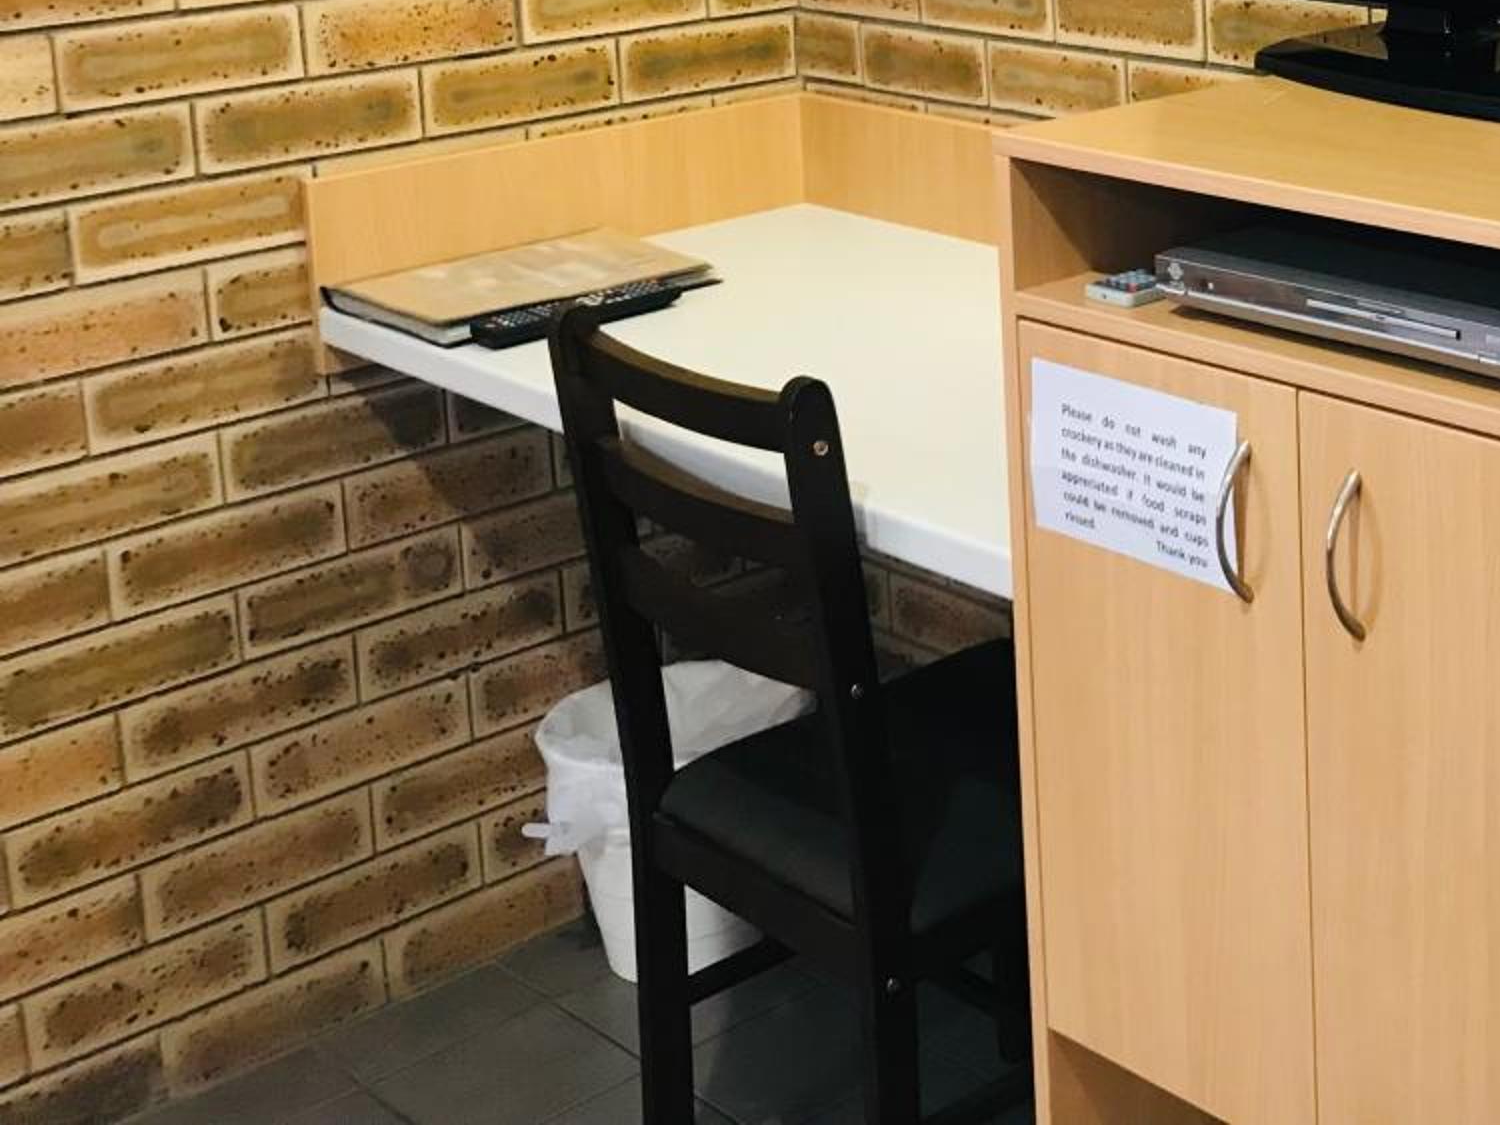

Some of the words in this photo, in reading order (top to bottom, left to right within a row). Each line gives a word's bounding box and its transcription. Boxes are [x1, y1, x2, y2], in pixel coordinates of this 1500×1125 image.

[1061, 427, 1102, 452] crockery
[1104, 440, 1114, 451] as
[1116, 441, 1137, 461] they
[1139, 451, 1152, 465] are
[1155, 455, 1194, 477] cleaned
[1196, 466, 1205, 482] in
[1062, 403, 1092, 422] Please
[1102, 415, 1115, 430] do
[1125, 423, 1141, 437] not
[1151, 433, 1177, 450] wash
[1188, 444, 1206, 460] any
[1061, 447, 1076, 463] the
[1156, 480, 1186, 497] would
[1192, 487, 1205, 502] be
[1061, 470, 1118, 496] appreciated
[1142, 493, 1165, 513] food
[1174, 506, 1207, 527] scraps
[1063, 490, 1089, 507] could
[1093, 498, 1106, 513] be
[1111, 506, 1154, 530] removed
[1160, 523, 1179, 538] and
[1185, 530, 1209, 548] cups
[1157, 540, 1185, 559] Thank
[1188, 553, 1208, 569] you
